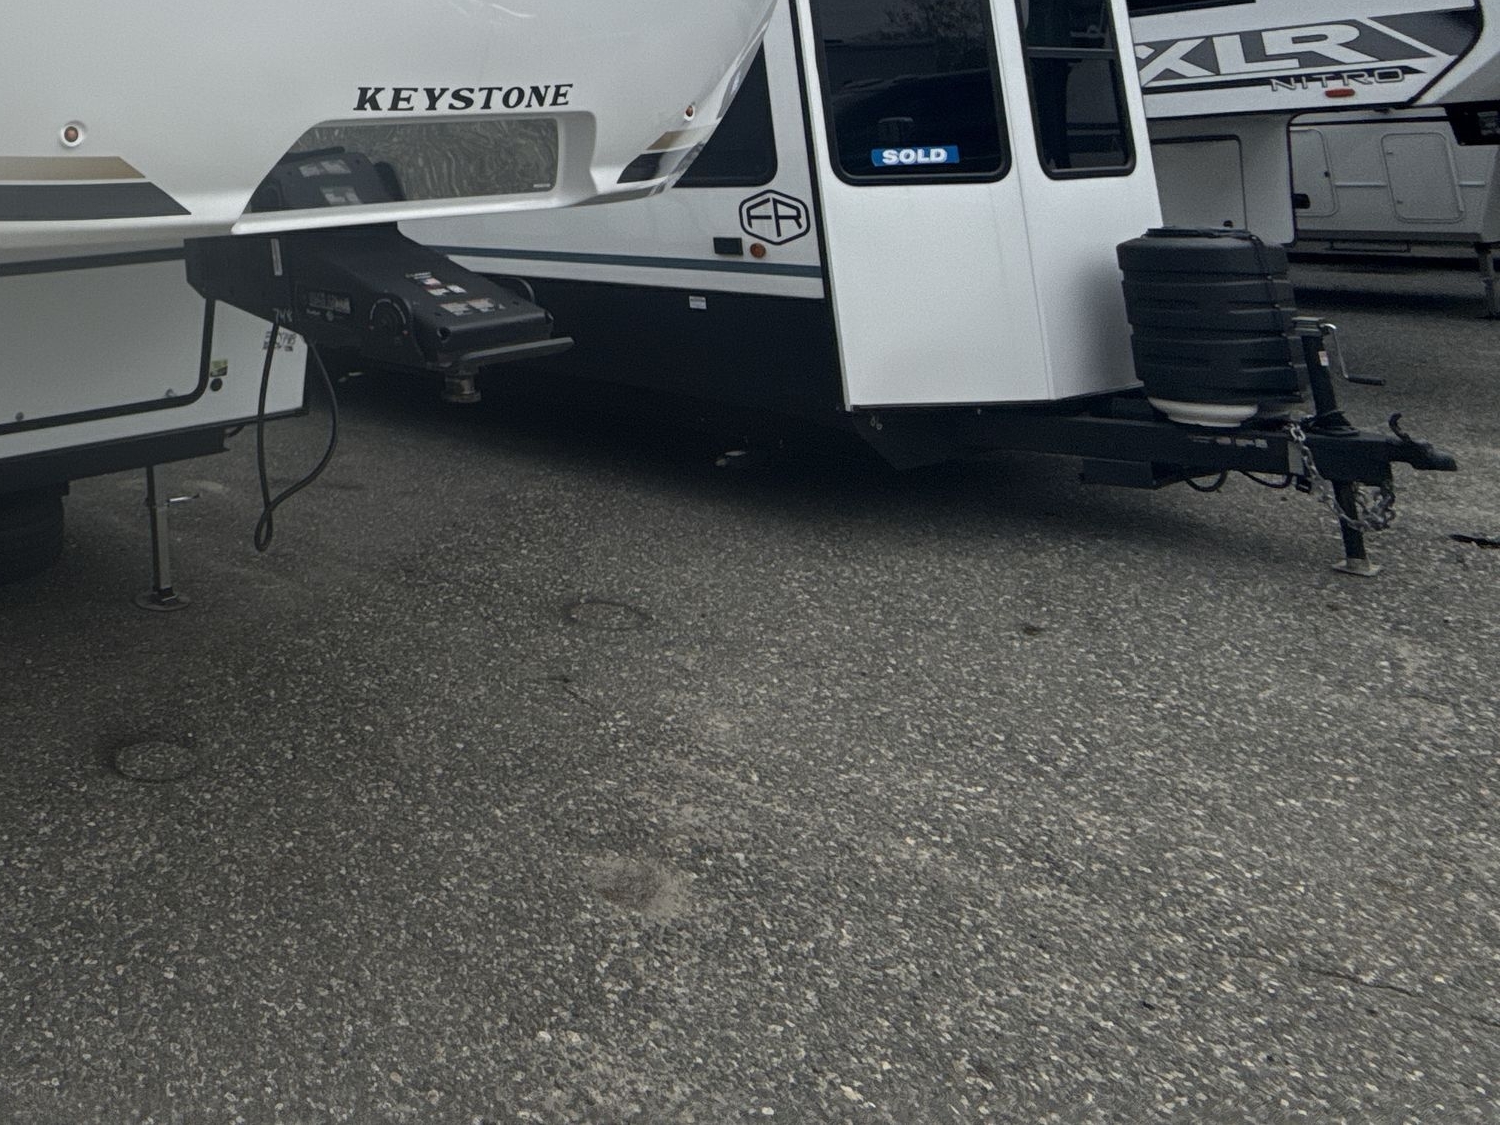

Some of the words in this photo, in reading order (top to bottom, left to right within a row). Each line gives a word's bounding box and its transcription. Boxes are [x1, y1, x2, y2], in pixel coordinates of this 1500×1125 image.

[1134, 24, 1380, 87] XLR
[1270, 68, 1405, 92] NITRO
[353, 83, 573, 111] KEYSTONE
[882, 148, 948, 164] SOLD
